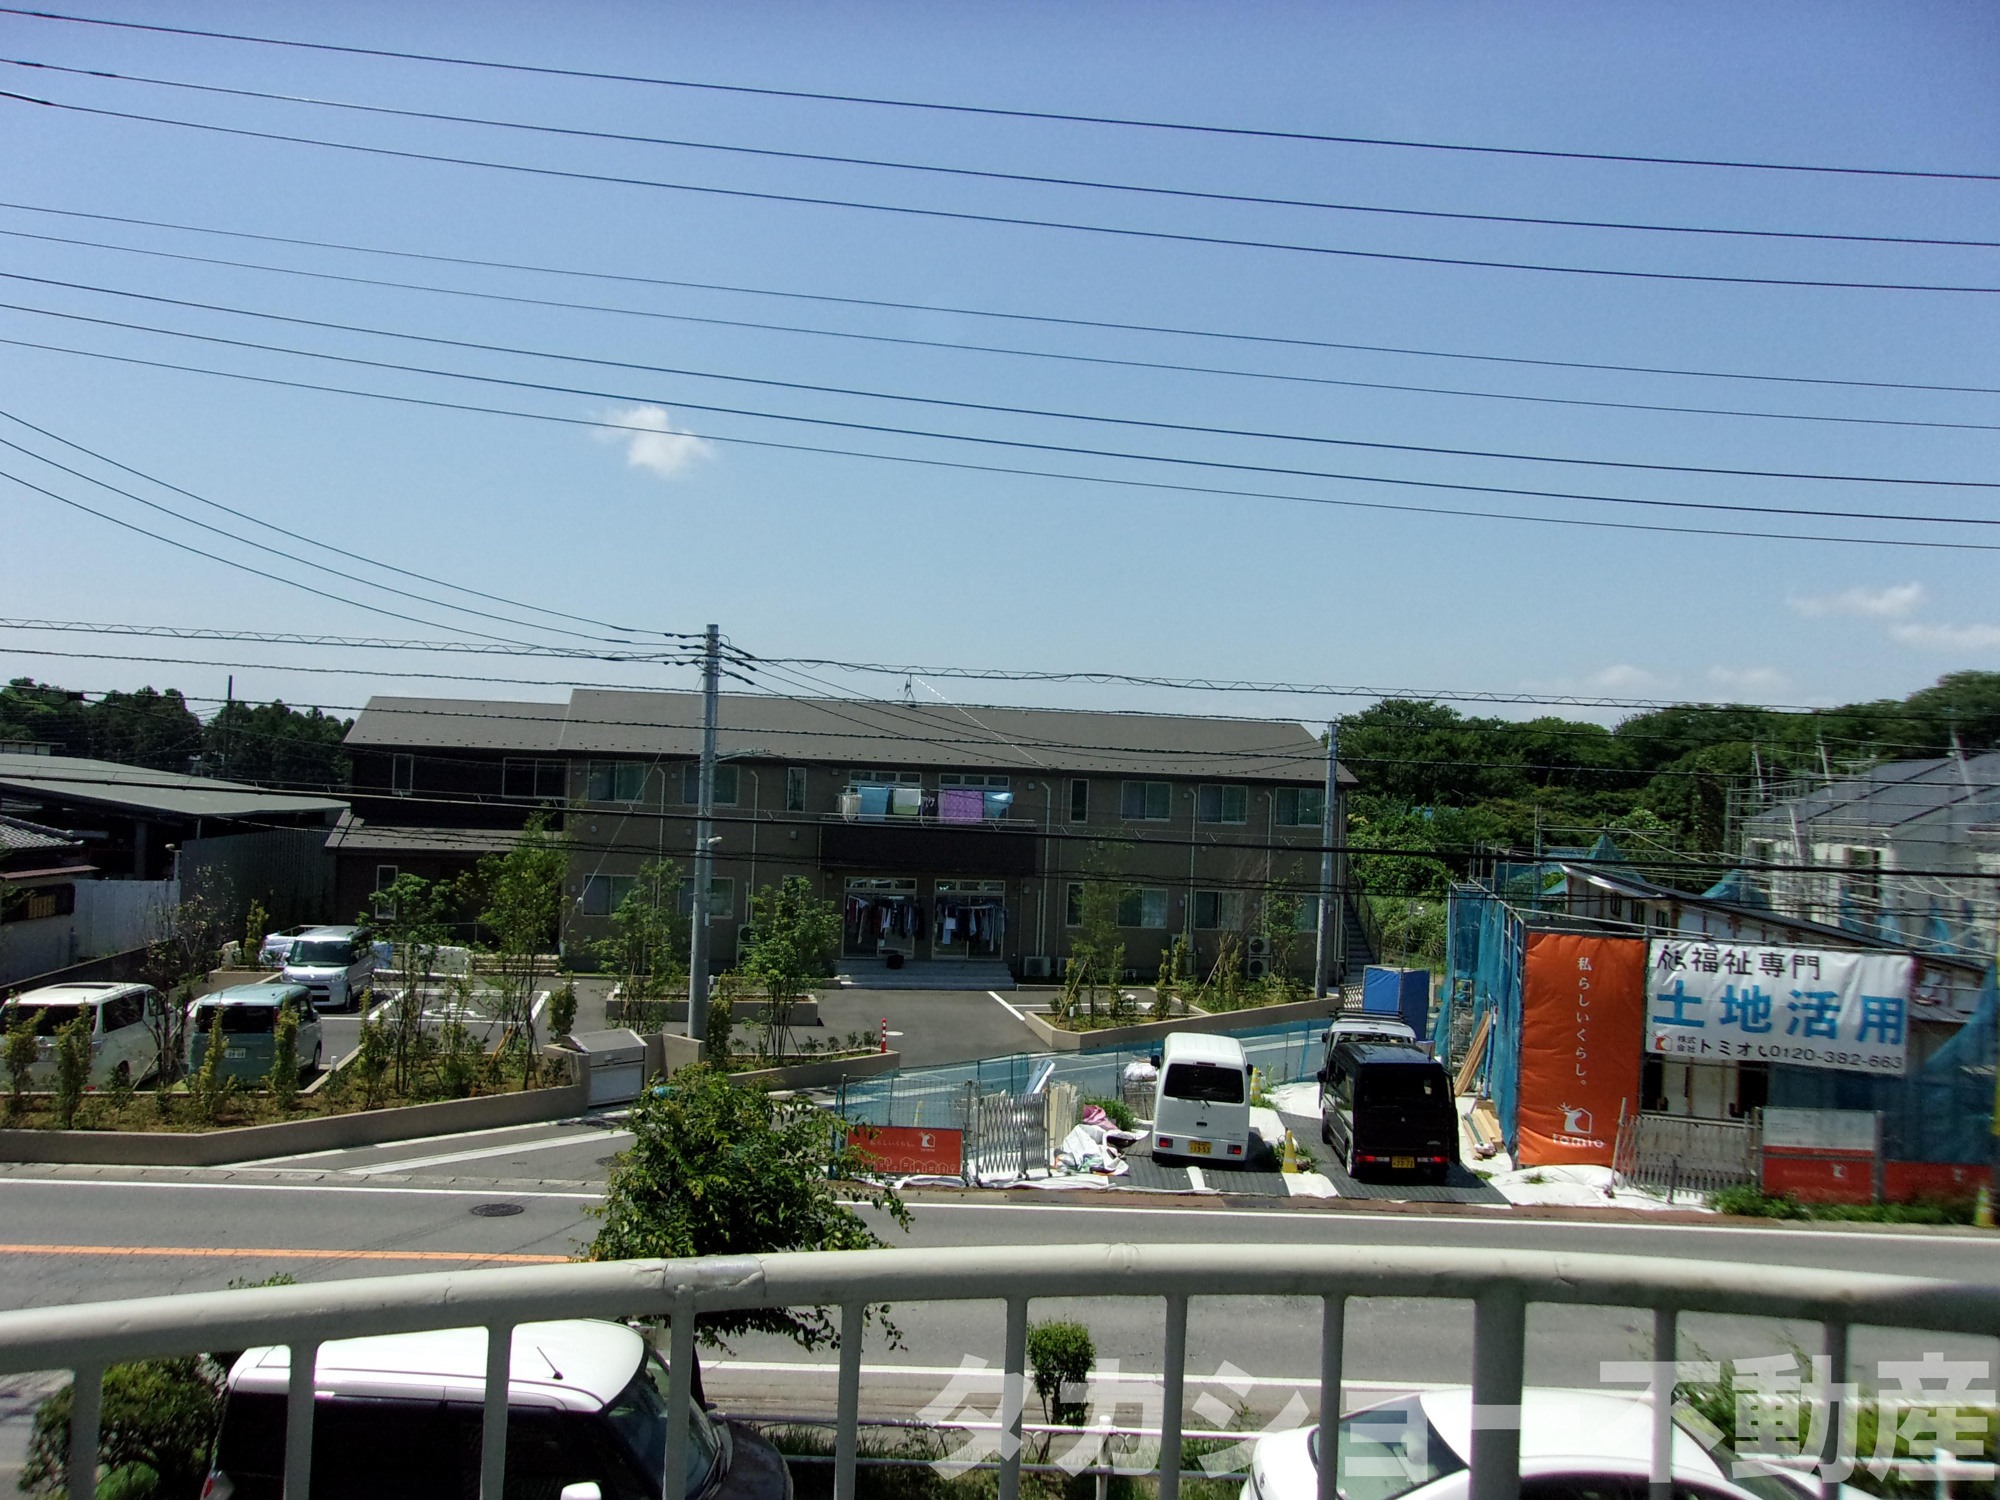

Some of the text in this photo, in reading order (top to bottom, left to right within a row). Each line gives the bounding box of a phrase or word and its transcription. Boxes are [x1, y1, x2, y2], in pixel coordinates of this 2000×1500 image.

[1690, 947, 1821, 981] 福祉専門
[1575, 956, 1593, 1086] 私らしいくらし。
[1652, 979, 1904, 1045] 土地活用
[1700, 1038, 1903, 1069] トミオ 0120-382-663
[1552, 1133, 1605, 1149] tomio
